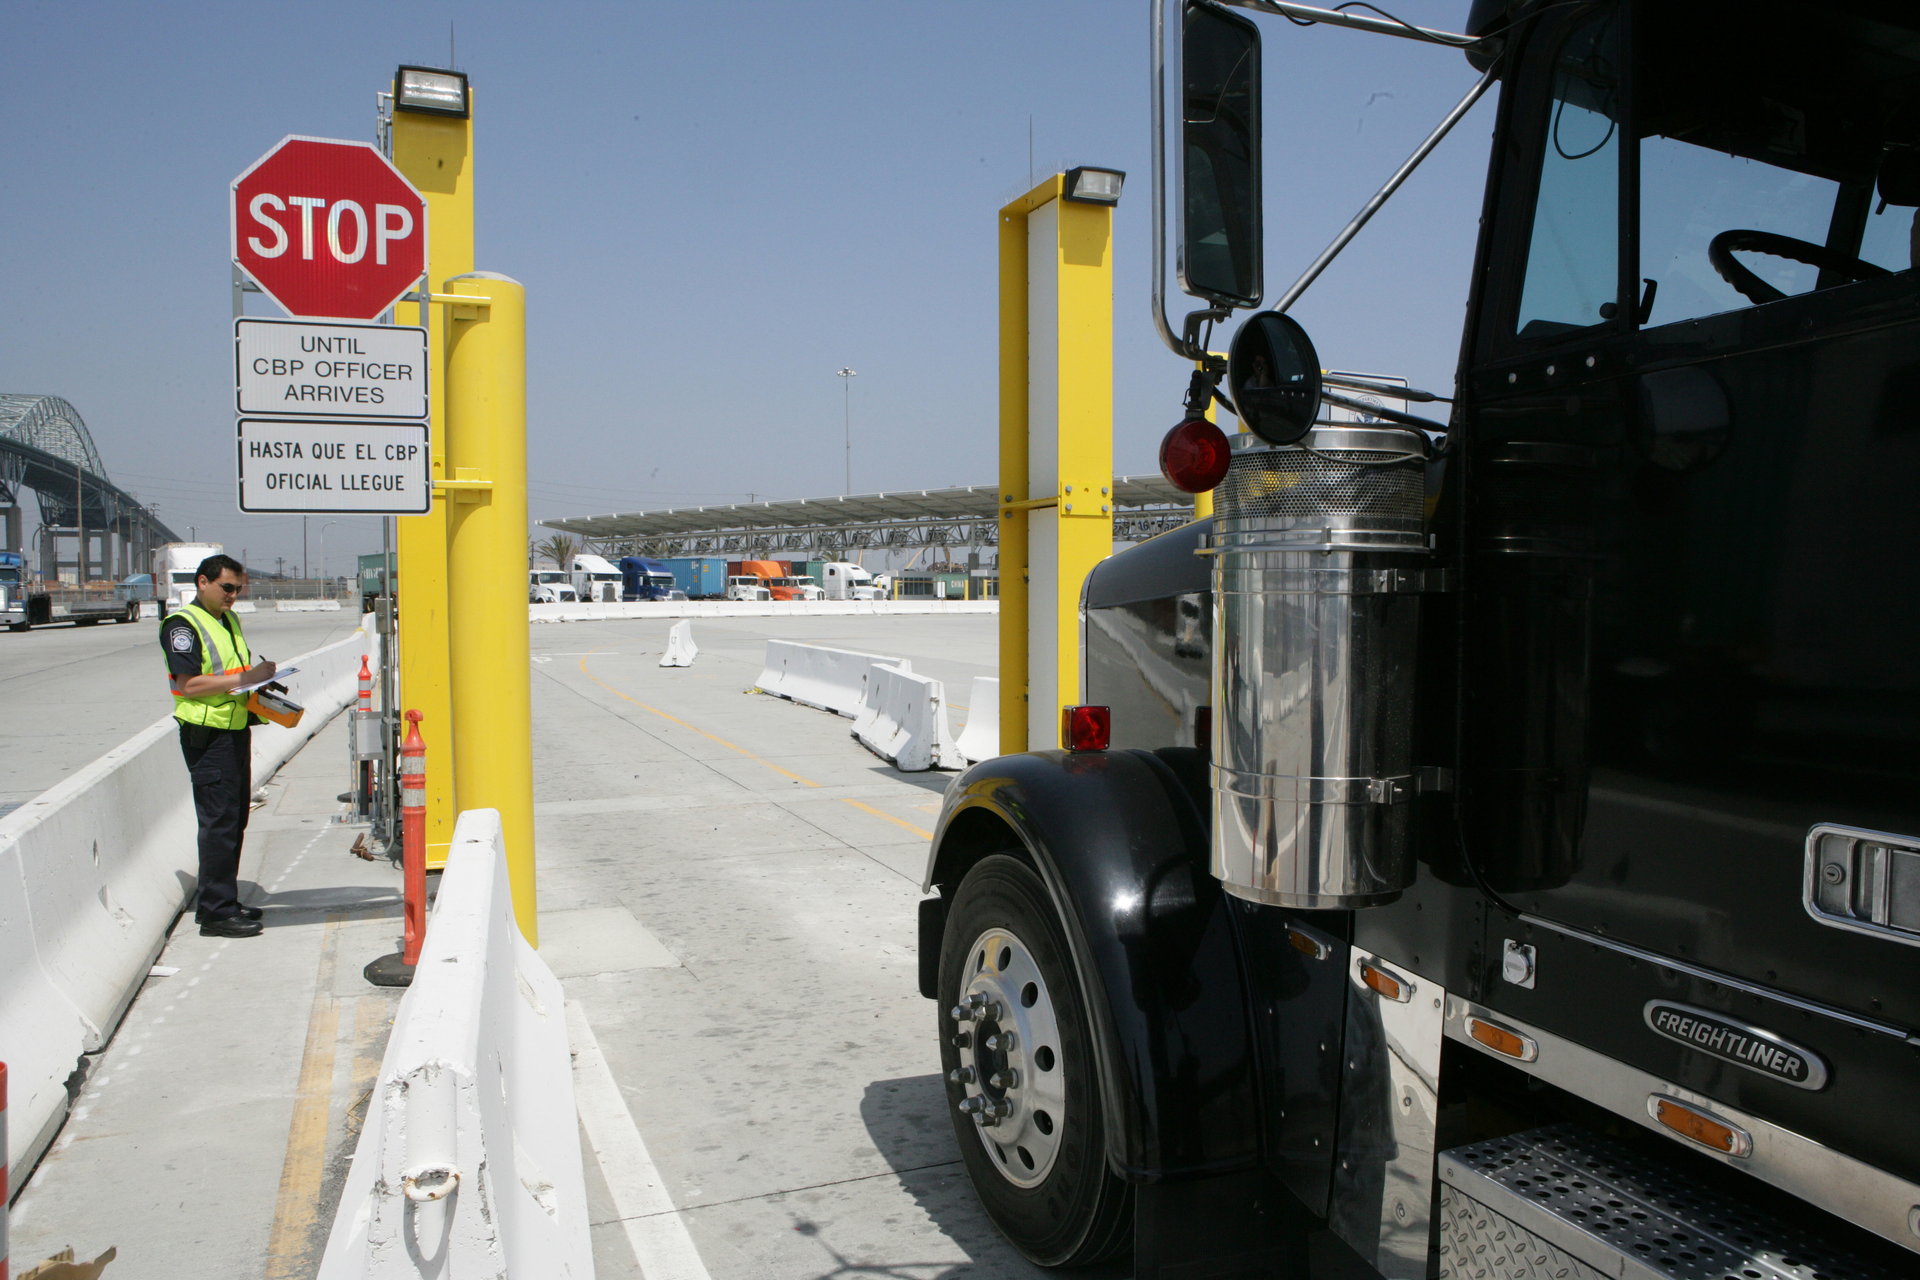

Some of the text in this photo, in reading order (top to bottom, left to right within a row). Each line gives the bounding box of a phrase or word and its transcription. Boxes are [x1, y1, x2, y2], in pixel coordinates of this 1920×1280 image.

[248, 193, 414, 265] STOP
[301, 336, 366, 355] UNTIL
[253, 358, 413, 381] CBP OFFICER
[285, 384, 385, 404] ARRIVES
[250, 442, 418, 461] HASTA QUE EL CBP
[266, 473, 405, 491] OFICIAL LLEGUE
[1656, 1011, 1801, 1077] FREIGHTLINER
